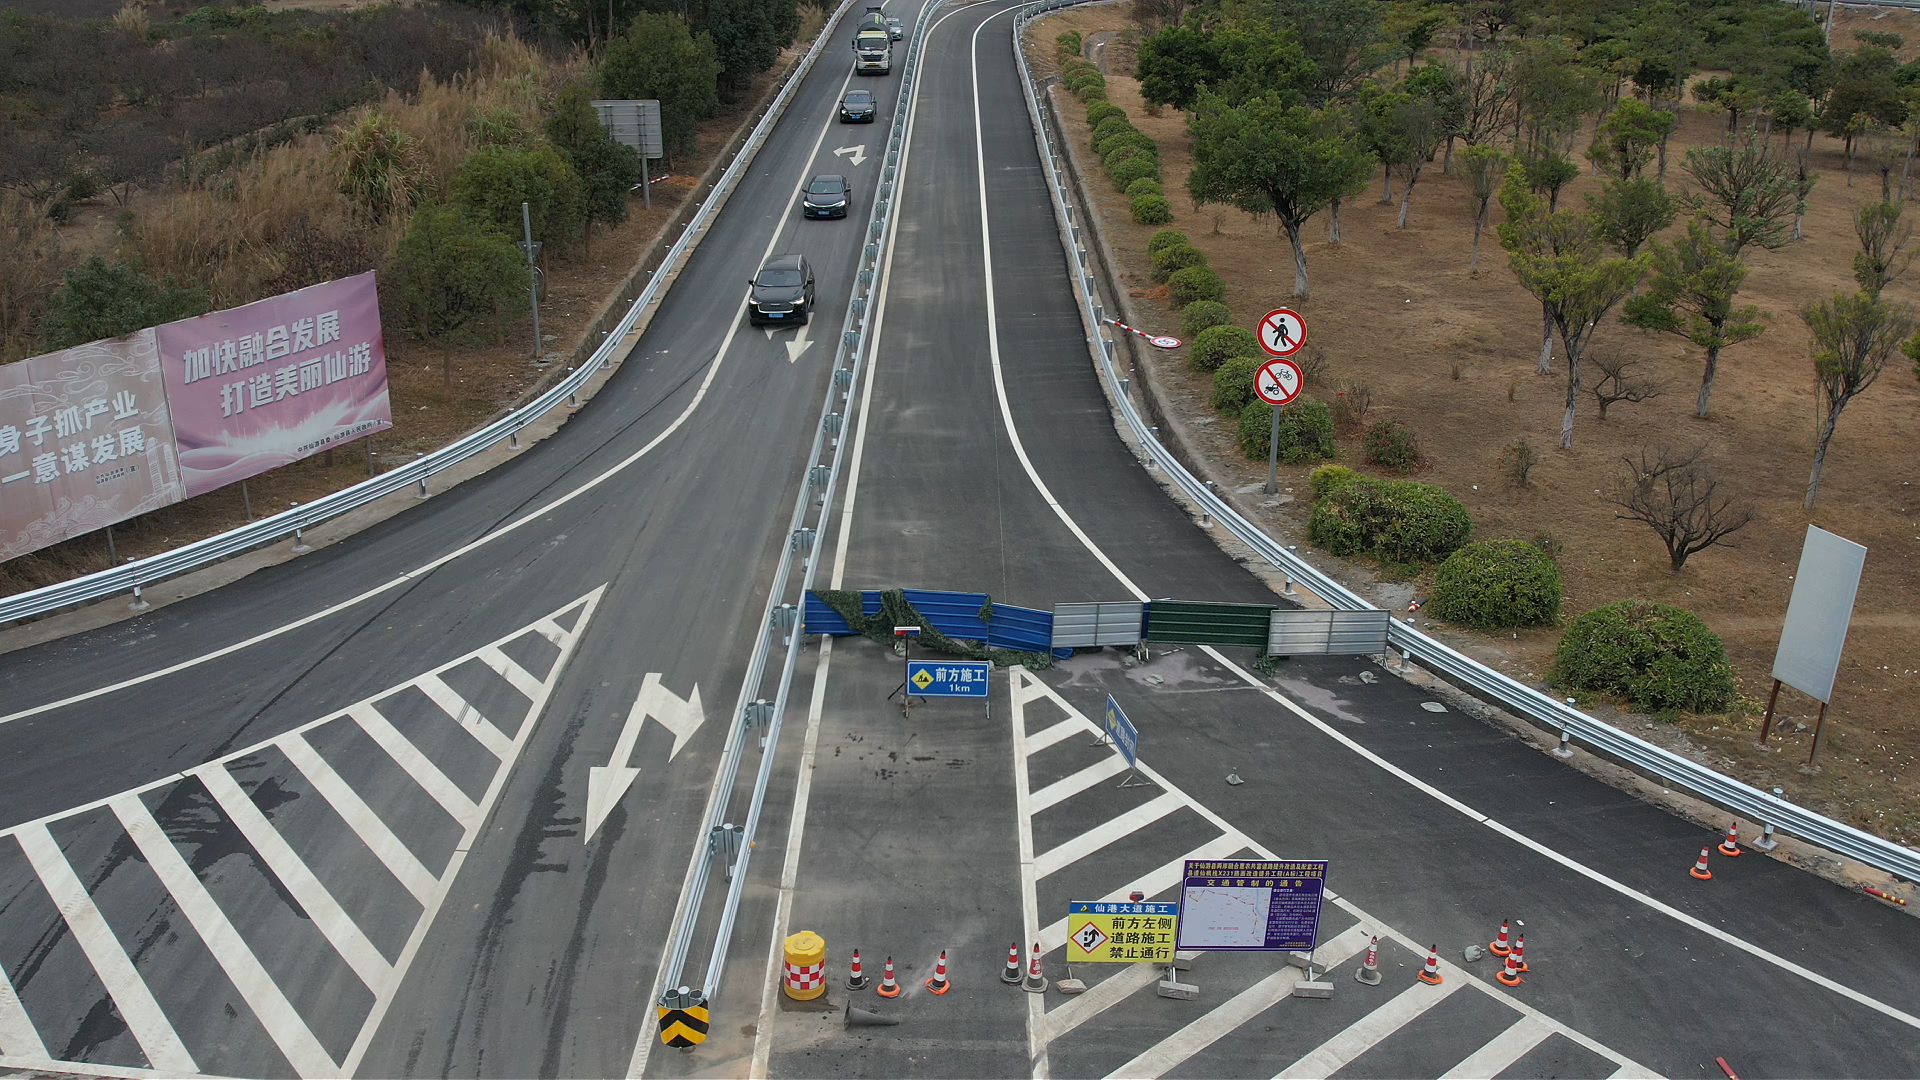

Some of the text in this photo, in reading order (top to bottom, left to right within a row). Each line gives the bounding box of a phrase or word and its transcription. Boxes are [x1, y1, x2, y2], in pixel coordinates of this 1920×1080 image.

[183, 309, 340, 385] 加快融合发展
[220, 342, 371, 419] 打造美丽仙游
[0, 390, 139, 458] 身子抓产业
[1, 425, 145, 485] 一意谋发展
[935, 667, 985, 683] 前方施工
[949, 684, 970, 692] 1km
[1206, 879, 1303, 887] 交通管制的通告
[1095, 904, 1168, 913] 仙港大道施工
[1111, 917, 1172, 930] 前方左侧
[1110, 932, 1170, 944] 道路施工
[1109, 947, 1170, 959] 禁止通行
